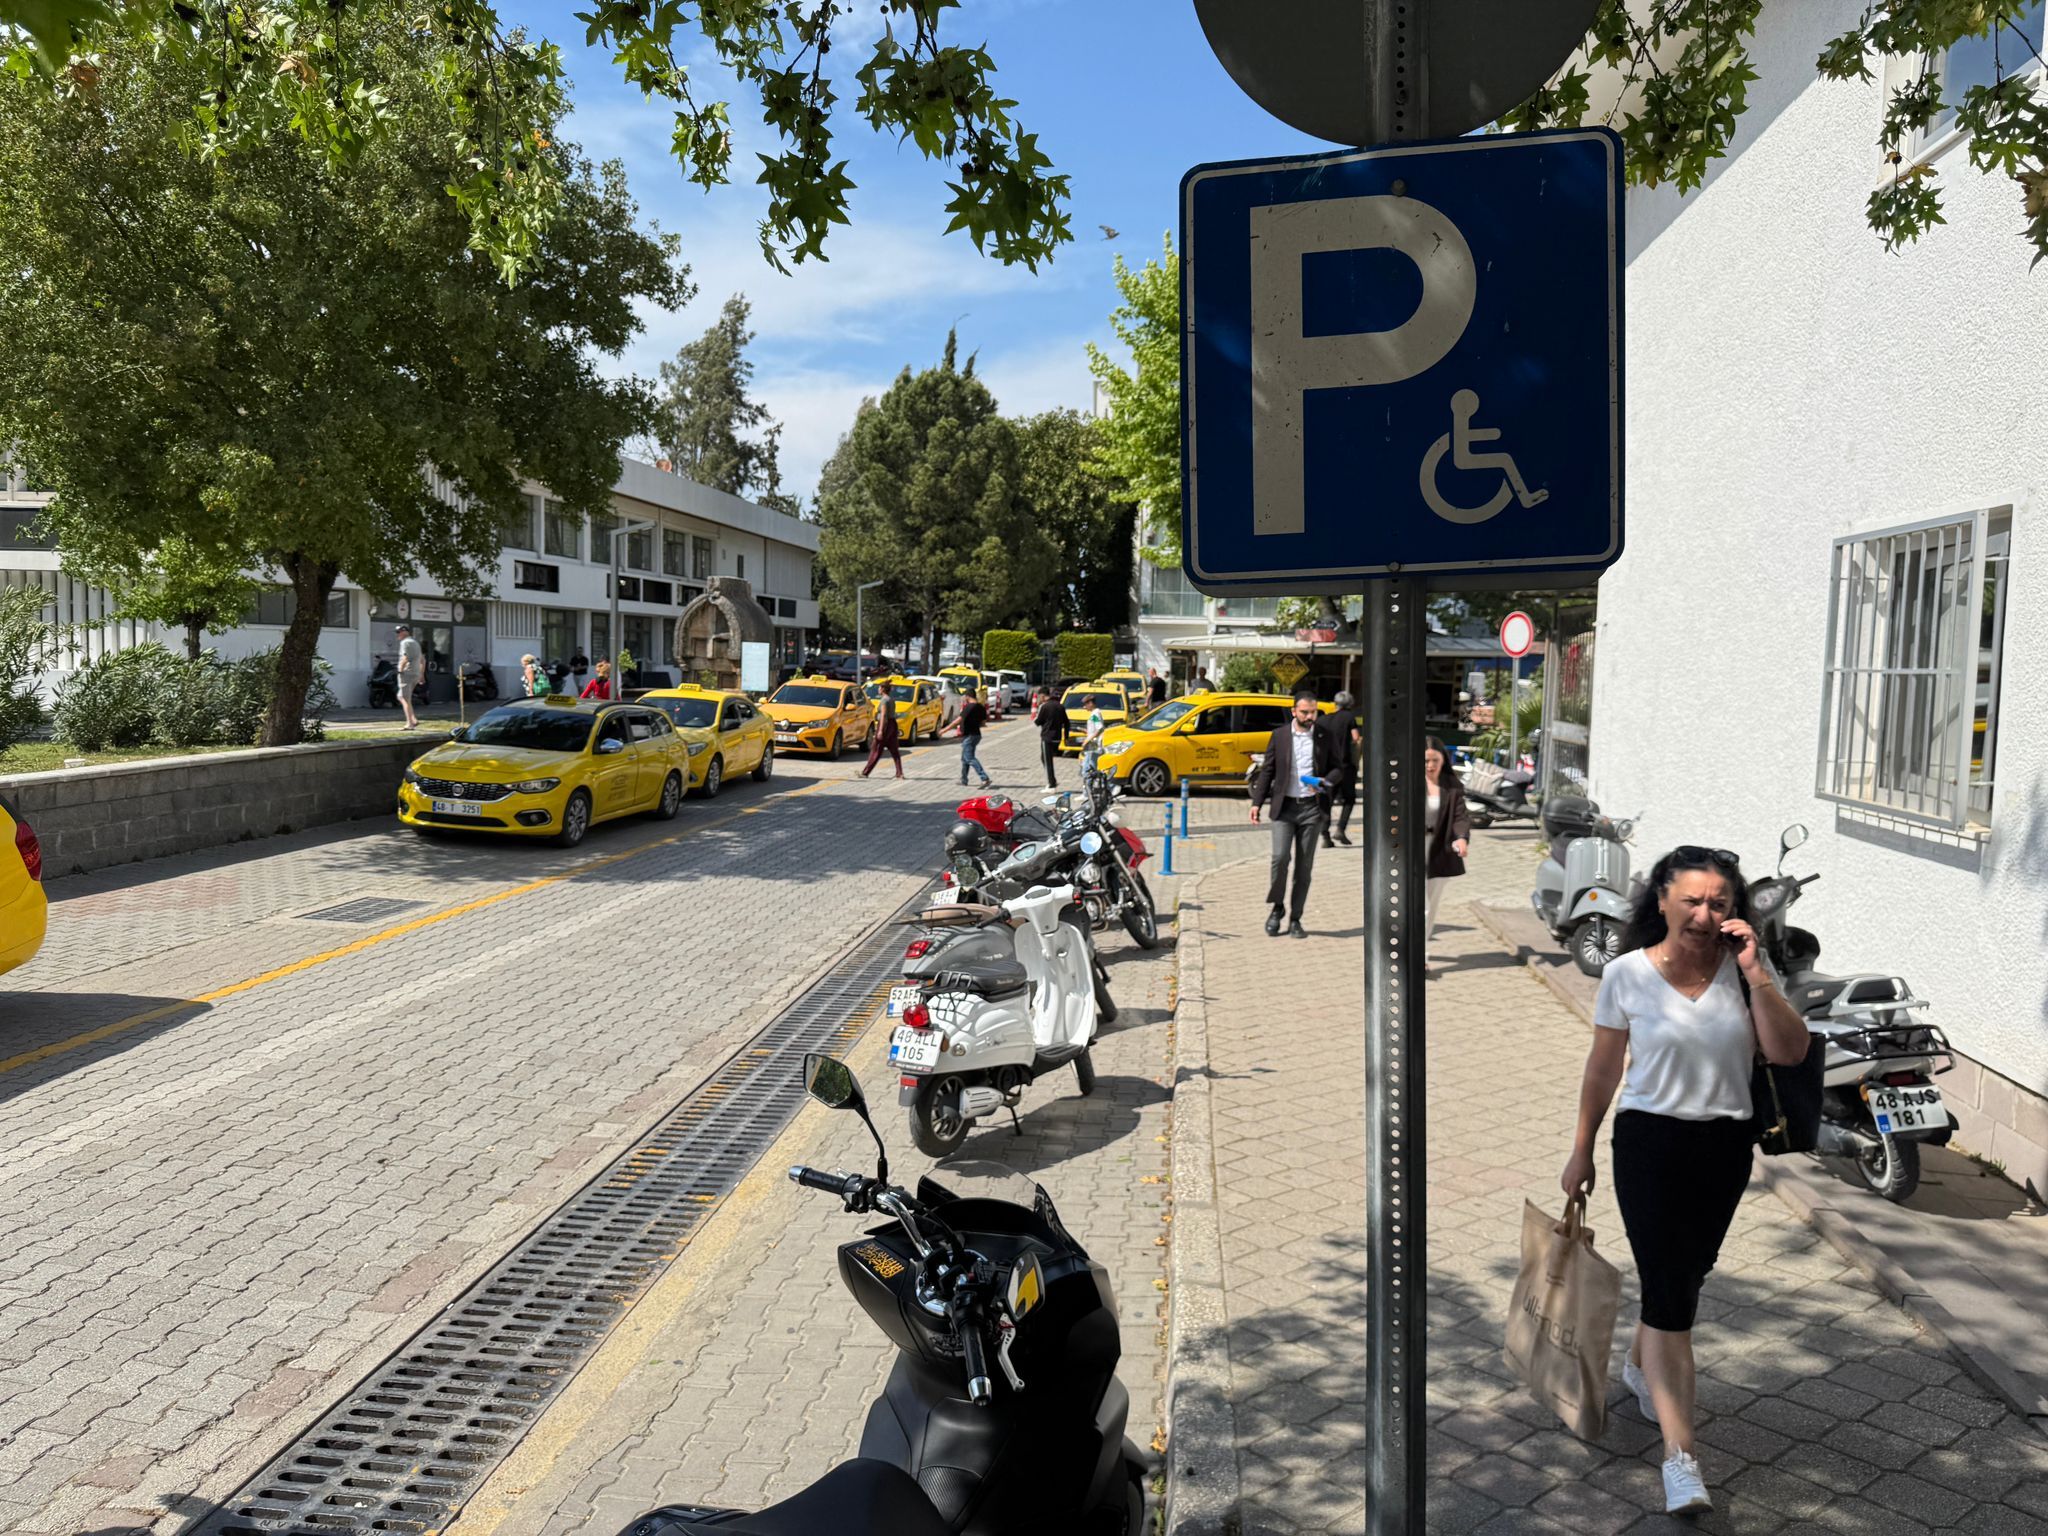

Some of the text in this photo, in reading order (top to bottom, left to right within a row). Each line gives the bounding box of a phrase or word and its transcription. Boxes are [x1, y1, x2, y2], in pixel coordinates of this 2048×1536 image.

[1250, 195, 1477, 536] P
[437, 801, 446, 811] 48
[462, 804, 480, 815] 3251
[892, 989, 903, 1001] 52
[897, 1029, 938, 1048] 48 ALL
[902, 1046, 924, 1061] 105
[1876, 1089, 1937, 1110] 48 AJS
[1892, 1109, 1925, 1127] 181
